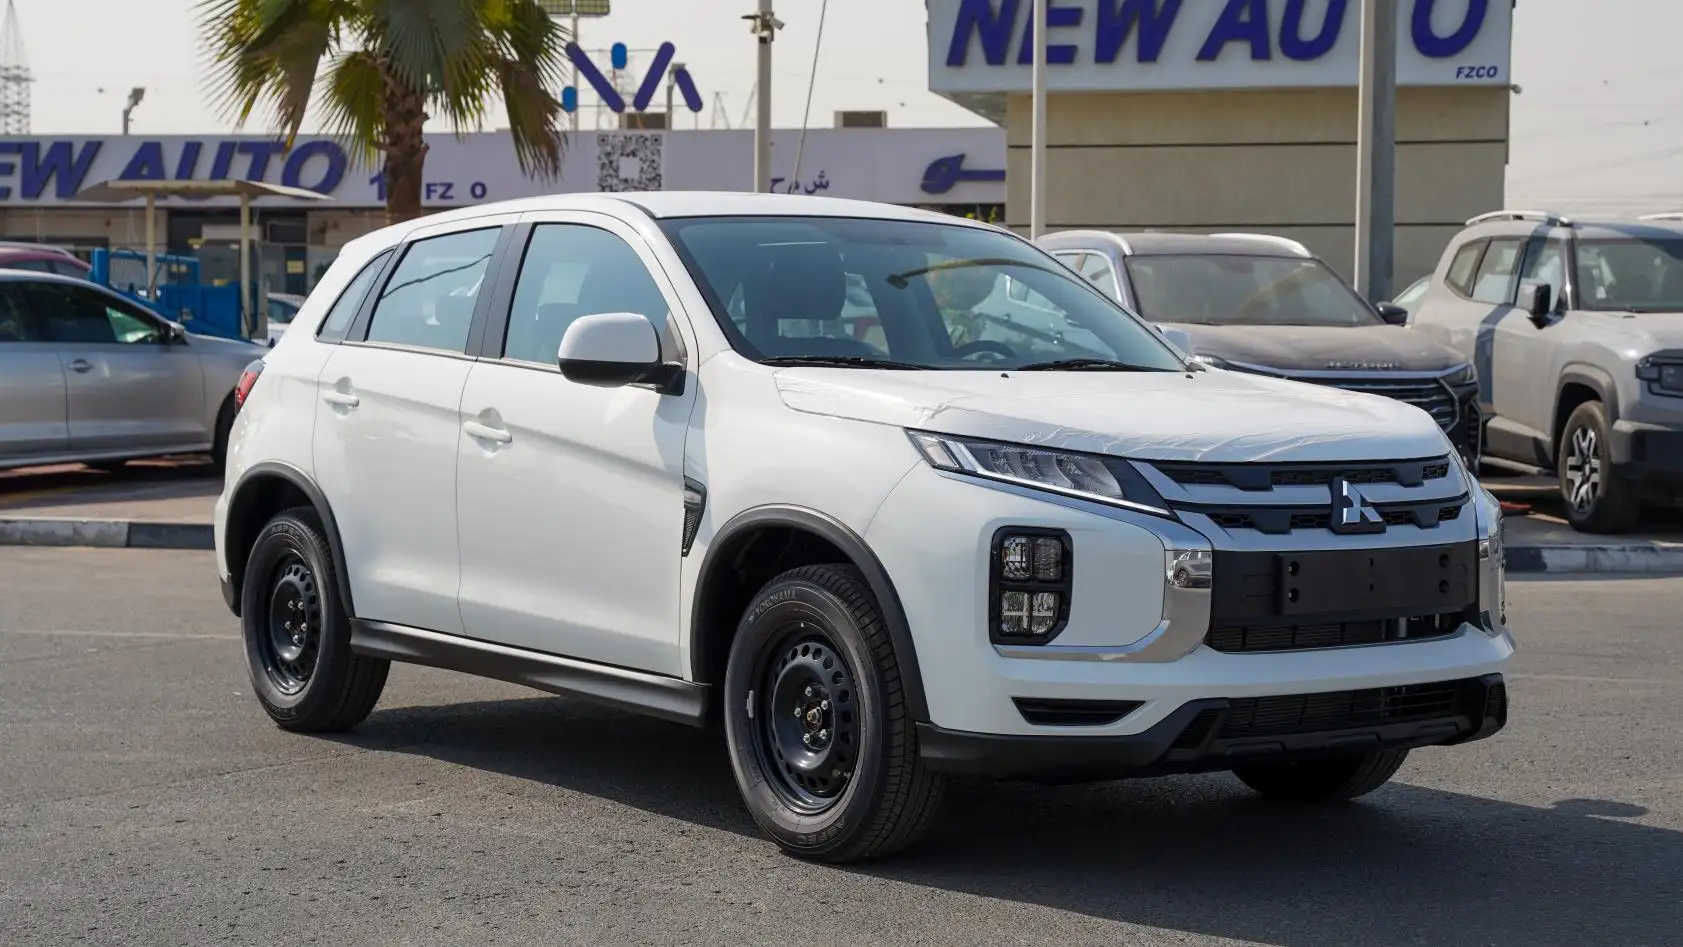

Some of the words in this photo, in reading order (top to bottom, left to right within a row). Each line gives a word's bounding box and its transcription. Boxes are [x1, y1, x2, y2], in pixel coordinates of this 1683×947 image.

[945, 0, 1186, 67] NEW
[1194, 0, 1489, 61] AUO
[1456, 66, 1499, 80] FZCO
[116, 140, 347, 201] AUTO
